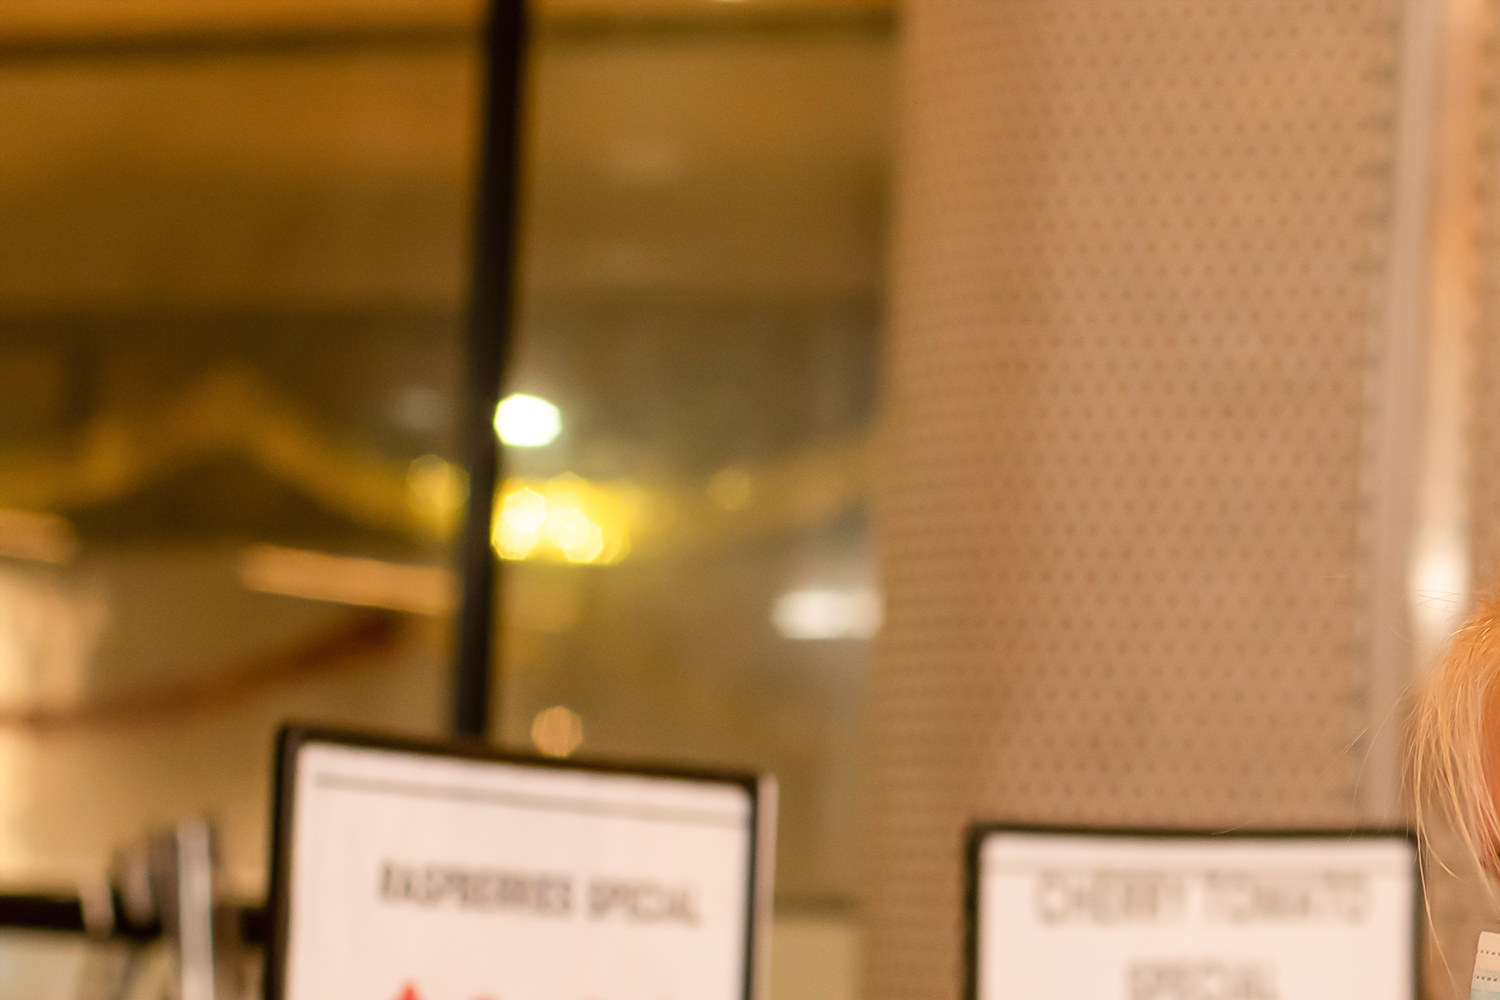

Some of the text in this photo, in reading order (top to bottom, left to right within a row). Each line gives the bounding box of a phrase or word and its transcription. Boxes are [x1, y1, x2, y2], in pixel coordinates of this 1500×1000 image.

[586, 877, 702, 927] SPECIAL
[1033, 870, 1372, 926] CHERRY TOMATO
